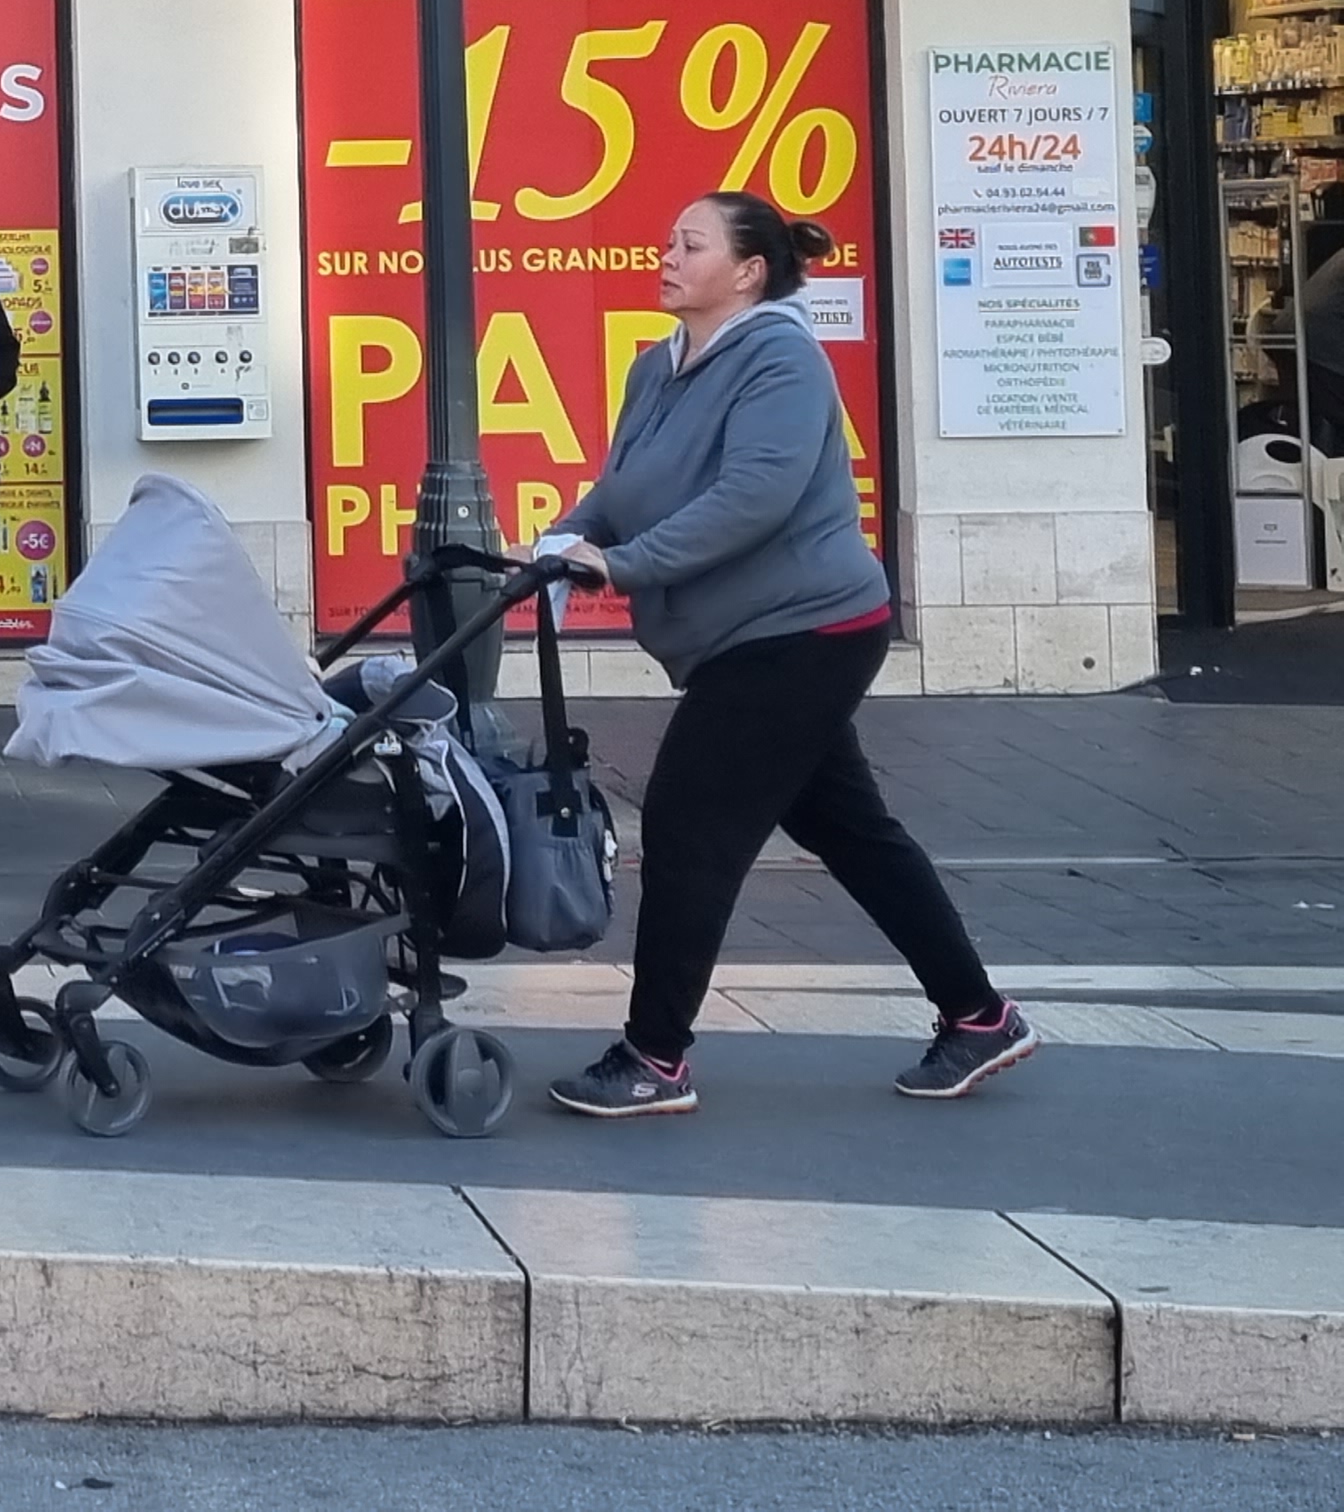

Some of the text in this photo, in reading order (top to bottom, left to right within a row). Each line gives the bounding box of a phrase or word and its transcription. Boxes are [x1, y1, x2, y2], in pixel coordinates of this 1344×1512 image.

[934, 51, 1112, 75] PHARMACIE
[988, 74, 1058, 101] Riviera
[939, 108, 1007, 124] OUVERT
[1014, 108, 1023, 123] 7
[1027, 107, 1082, 127] JOURS
[1099, 107, 1110, 121] 7
[968, 134, 1082, 162] 24h/24
[318, 251, 367, 275] SUR
[378, 250, 425, 274] NO
[473, 248, 512, 272] US
[522, 245, 661, 272] GRANDES
[994, 256, 1063, 270] AUTOTESTS
